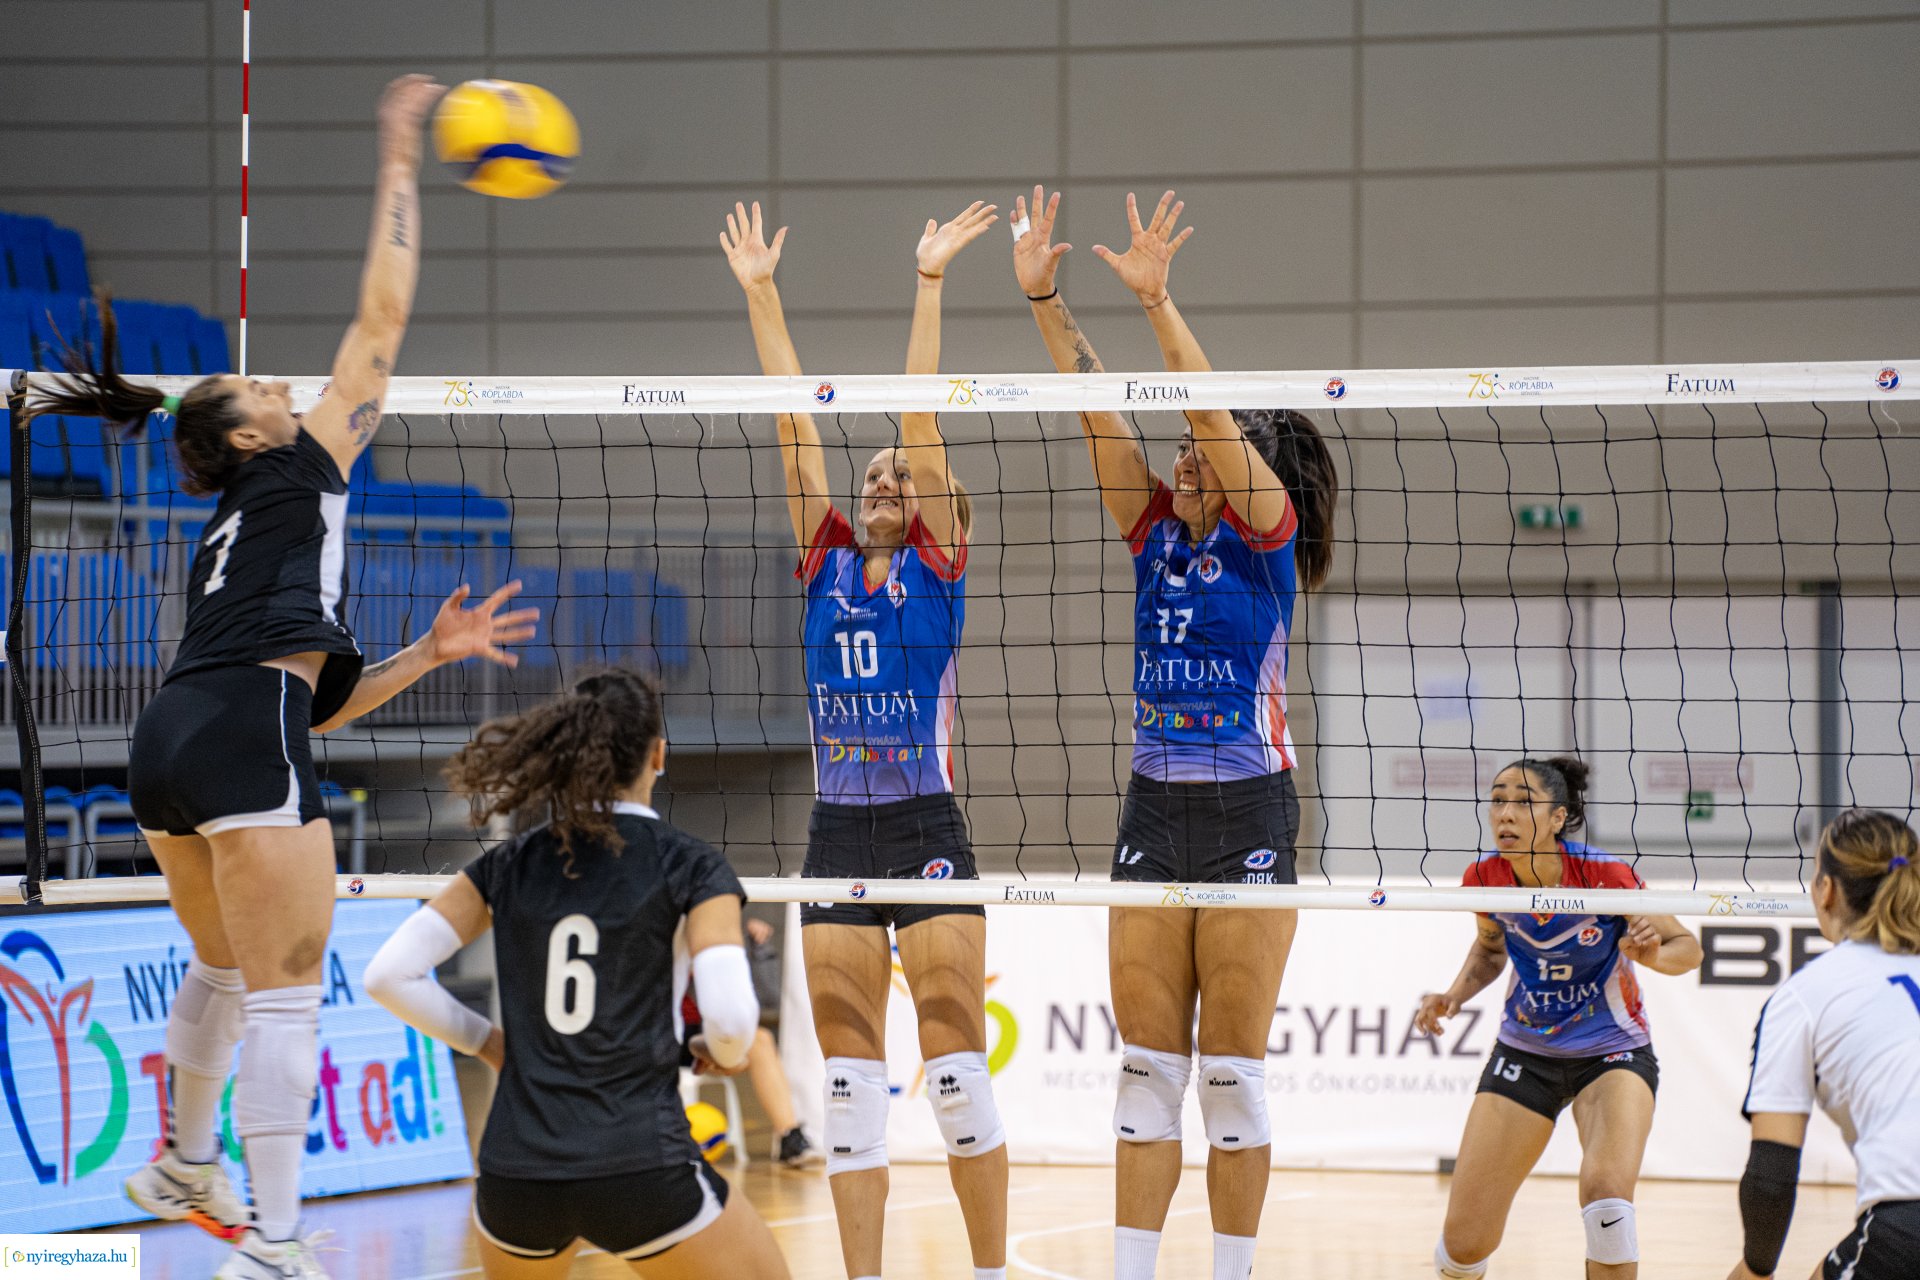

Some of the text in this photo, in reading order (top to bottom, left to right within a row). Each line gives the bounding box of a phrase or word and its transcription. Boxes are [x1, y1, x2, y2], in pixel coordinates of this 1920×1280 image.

[1156, 607, 1194, 644] 17
[834, 630, 879, 680] 10
[544, 913, 600, 1036] 6
